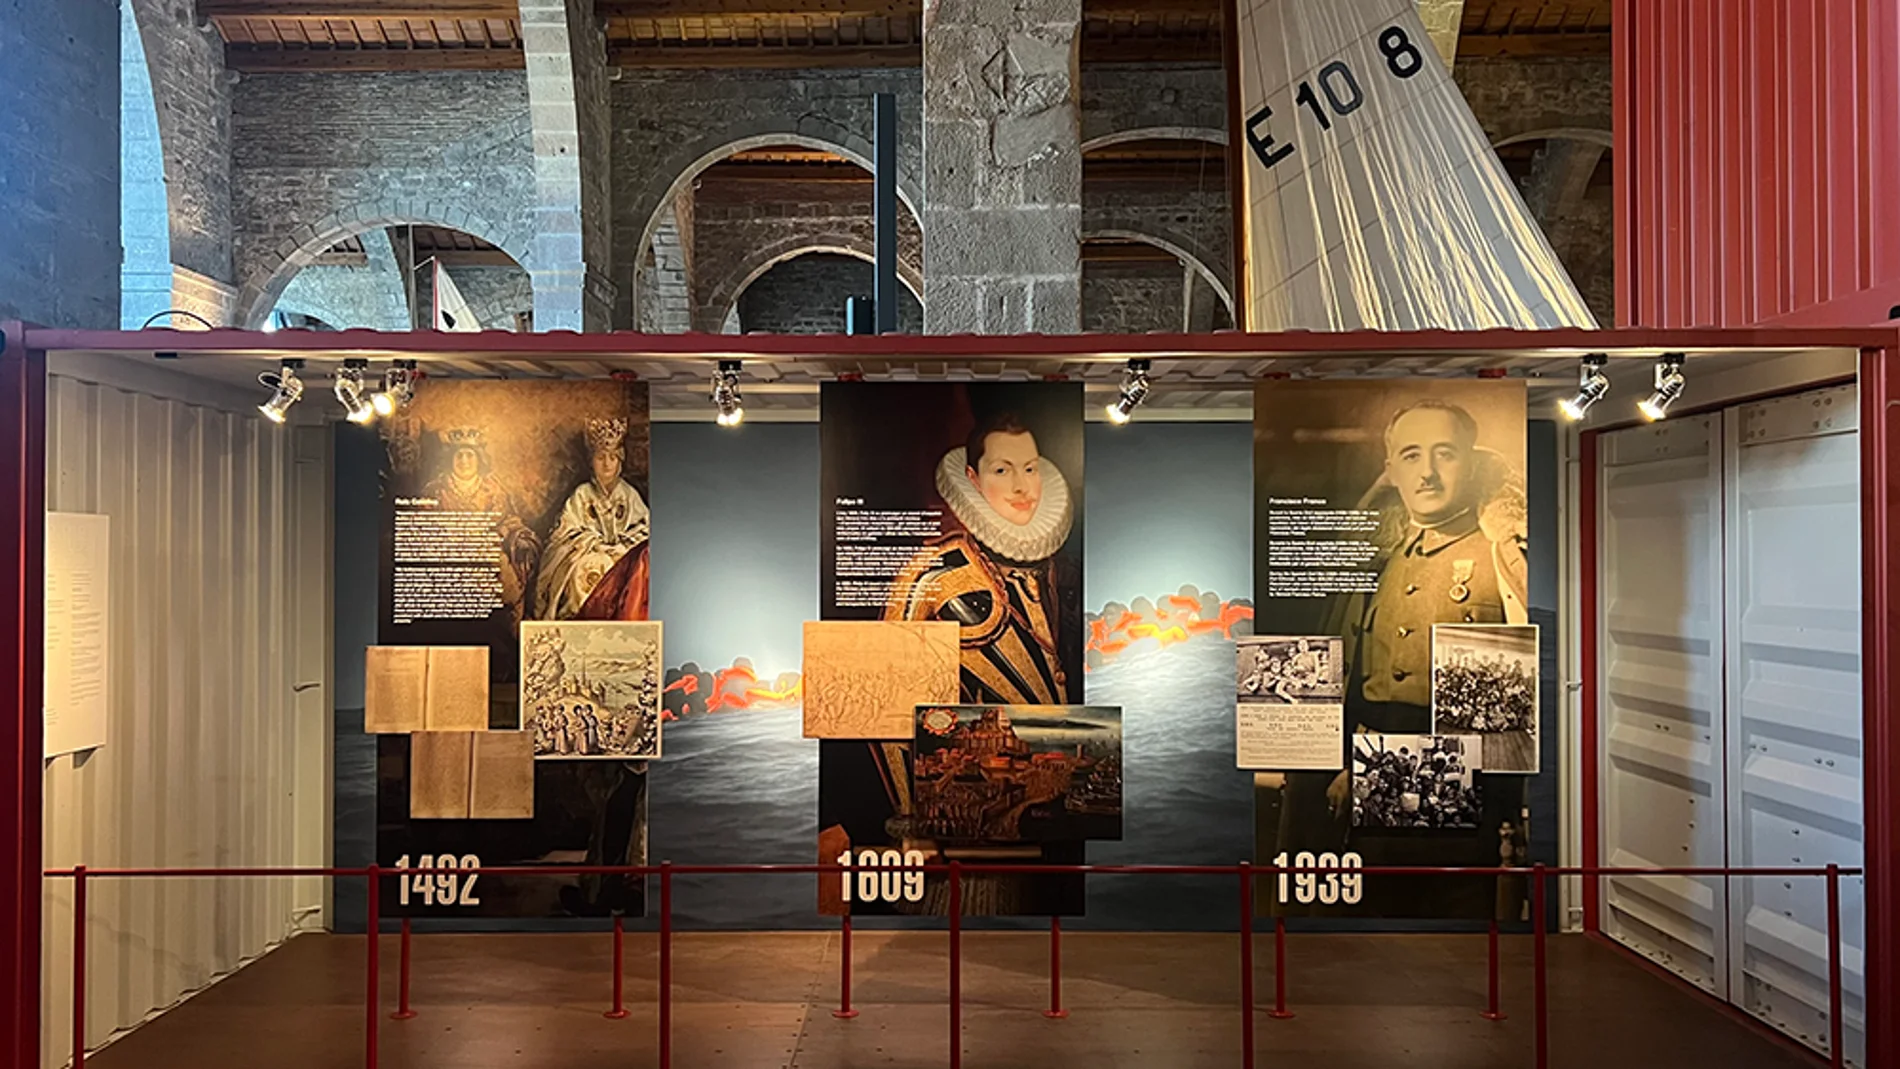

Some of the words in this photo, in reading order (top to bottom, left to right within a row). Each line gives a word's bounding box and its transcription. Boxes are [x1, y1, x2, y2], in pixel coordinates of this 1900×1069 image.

[1245, 105, 1295, 169] E
[395, 854, 481, 905] 1492
[837, 850, 924, 902] 1609
[1273, 851, 1363, 904] 1939
